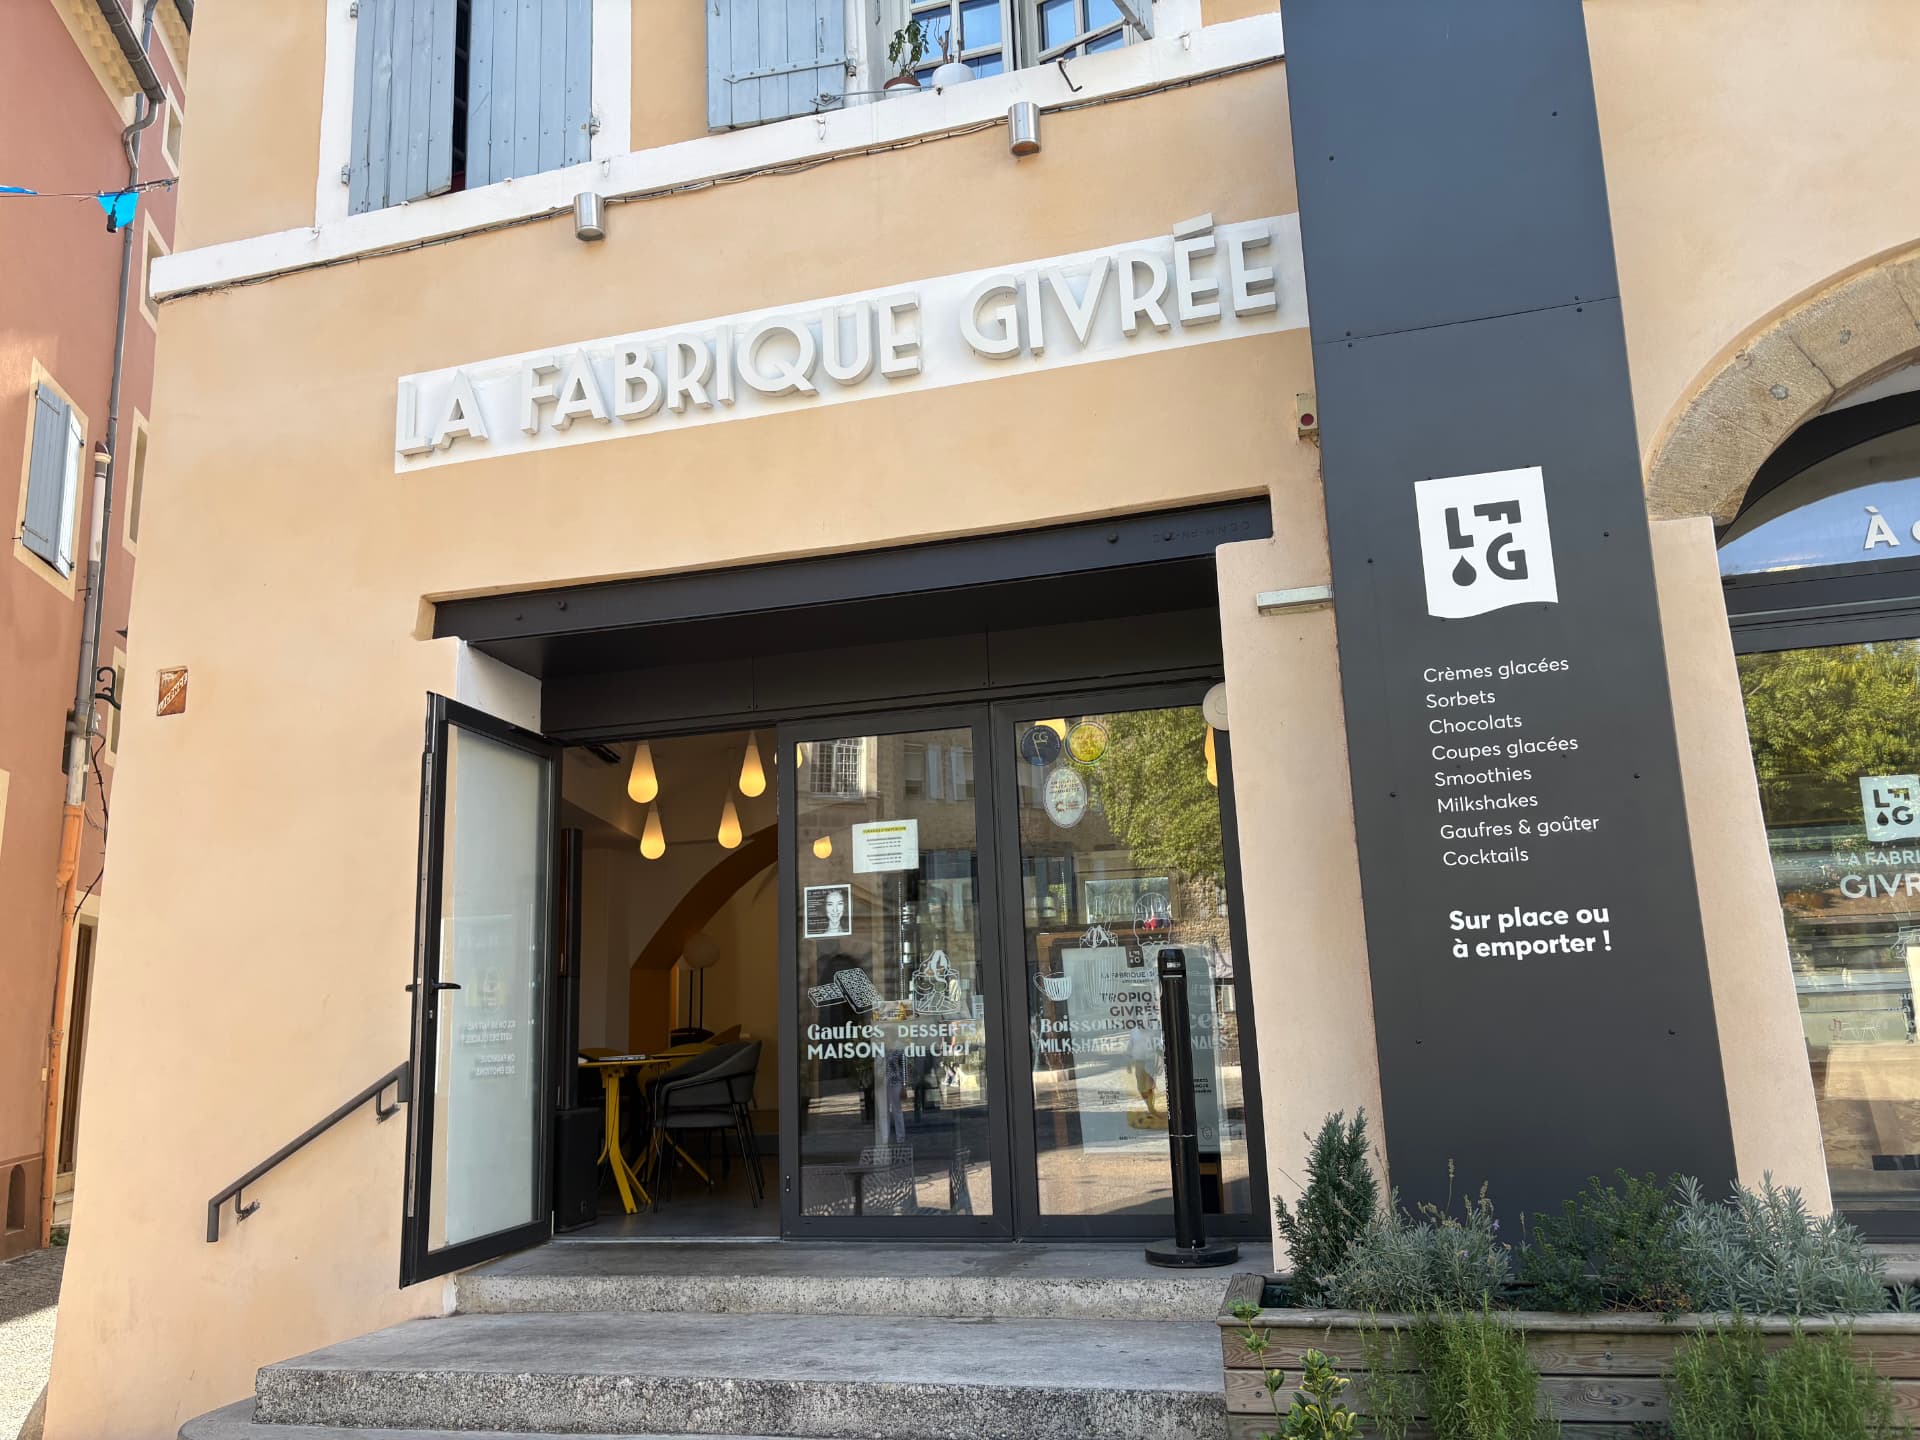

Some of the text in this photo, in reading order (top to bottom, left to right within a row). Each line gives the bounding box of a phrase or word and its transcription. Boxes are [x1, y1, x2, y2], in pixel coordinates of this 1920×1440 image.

[396, 213, 1278, 457] LA FABRIQUE GIVRÉE
[1864, 505, 1901, 550] À
[1423, 657, 1570, 683] Crèmes glacées
[1425, 690, 1497, 709] Sorbets
[1428, 713, 1523, 735] Chocolats
[1431, 736, 1579, 762] Coupes glacées
[1434, 767, 1533, 788] Smoothies
[1437, 792, 1539, 814] Milkshakes
[1440, 815, 1600, 840] Gaufres & goûter
[1442, 846, 1529, 867] Cocktails
[1449, 906, 1610, 934] Sur place ou
[1452, 929, 1613, 961] à emporter !
[807, 1020, 885, 1041] Gaufres
[898, 1022, 977, 1039] DESSERTS
[807, 1041, 886, 1061] MAISON
[904, 1041, 970, 1058] du Chef
